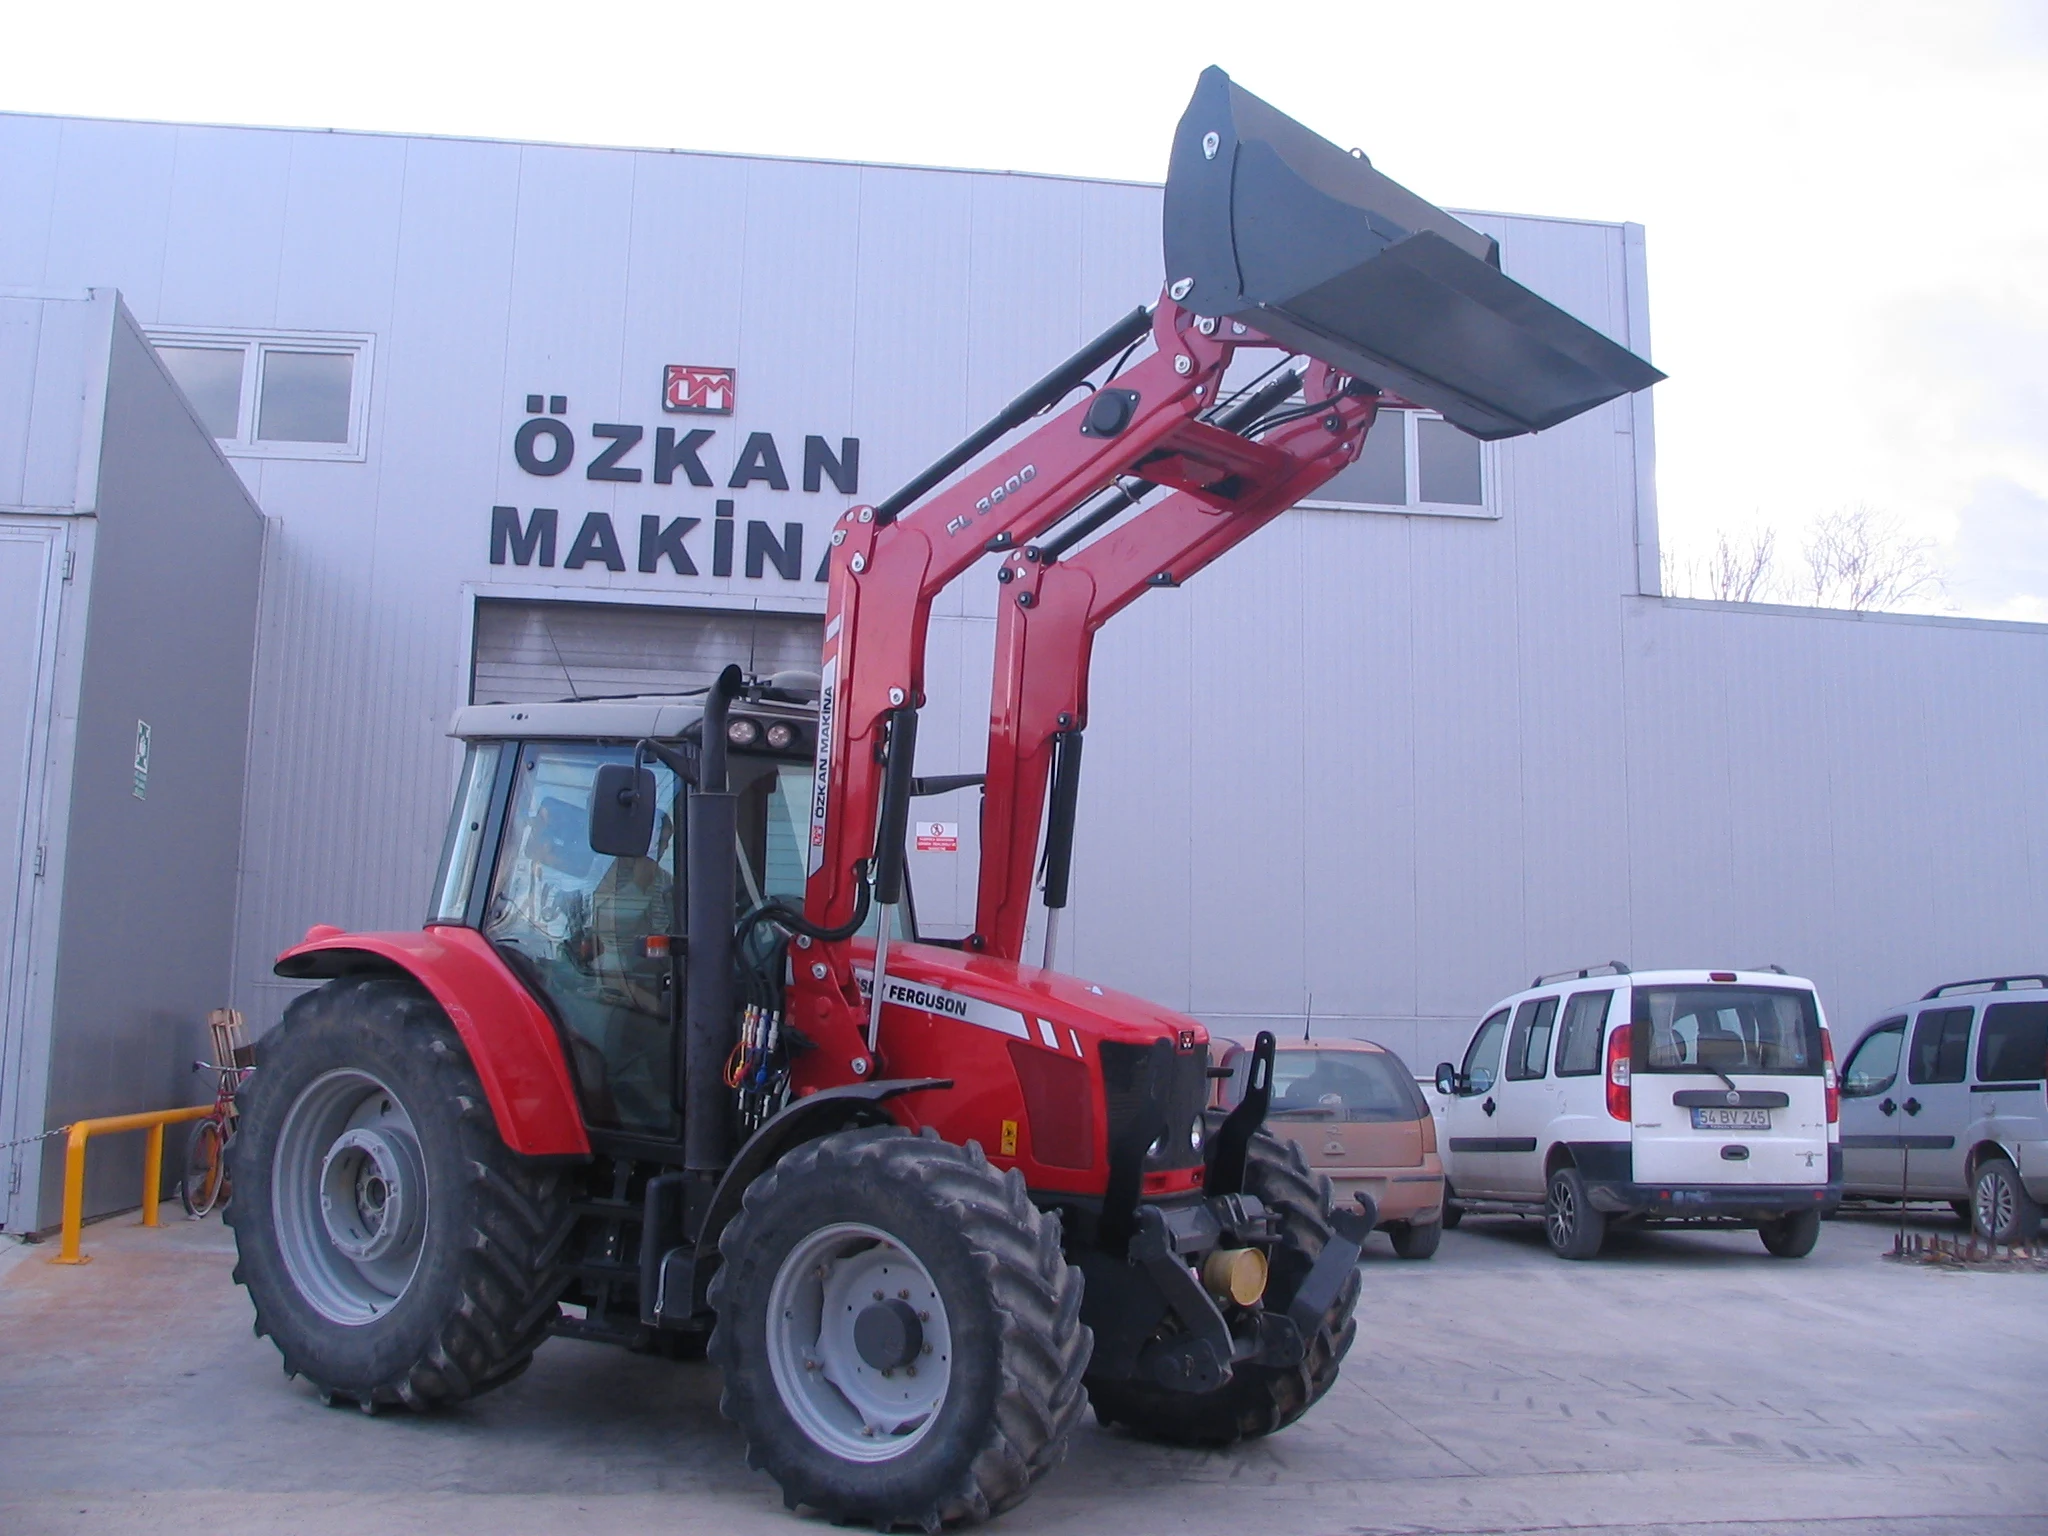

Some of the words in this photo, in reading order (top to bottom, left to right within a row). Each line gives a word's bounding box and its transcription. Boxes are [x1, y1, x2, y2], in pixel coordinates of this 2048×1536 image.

[514, 394, 860, 494] ÖZKAN
[946, 514, 973, 538] FL
[974, 463, 1037, 516] 3800
[820, 685, 833, 754] MAKİNA
[815, 758, 829, 819] ÖZKAN
[889, 985, 968, 1016] FERGUSON
[1700, 1110, 1716, 1124] 54
[1720, 1111, 1738, 1124] BV
[1743, 1111, 1766, 1124] 245
